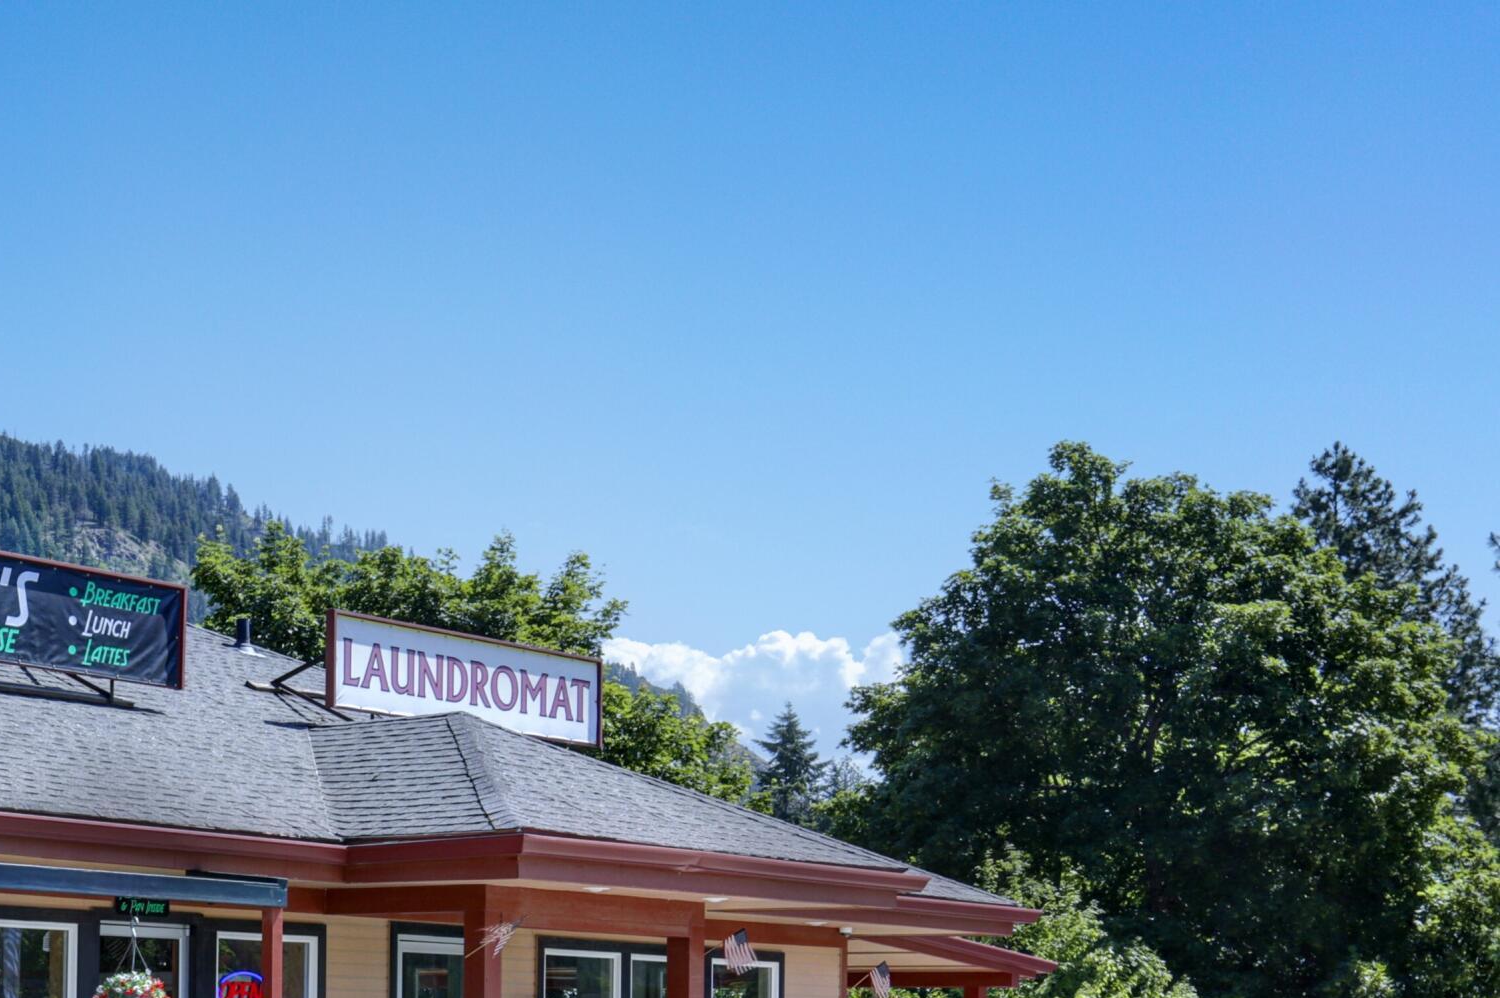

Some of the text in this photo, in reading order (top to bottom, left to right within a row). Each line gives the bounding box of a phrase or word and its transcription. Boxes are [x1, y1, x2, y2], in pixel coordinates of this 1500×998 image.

[80, 581, 161, 616] BREAKFAST
[81, 609, 132, 639] LUNCH
[81, 643, 130, 667] LATTES
[342, 637, 591, 723] LAUNDROMAT
